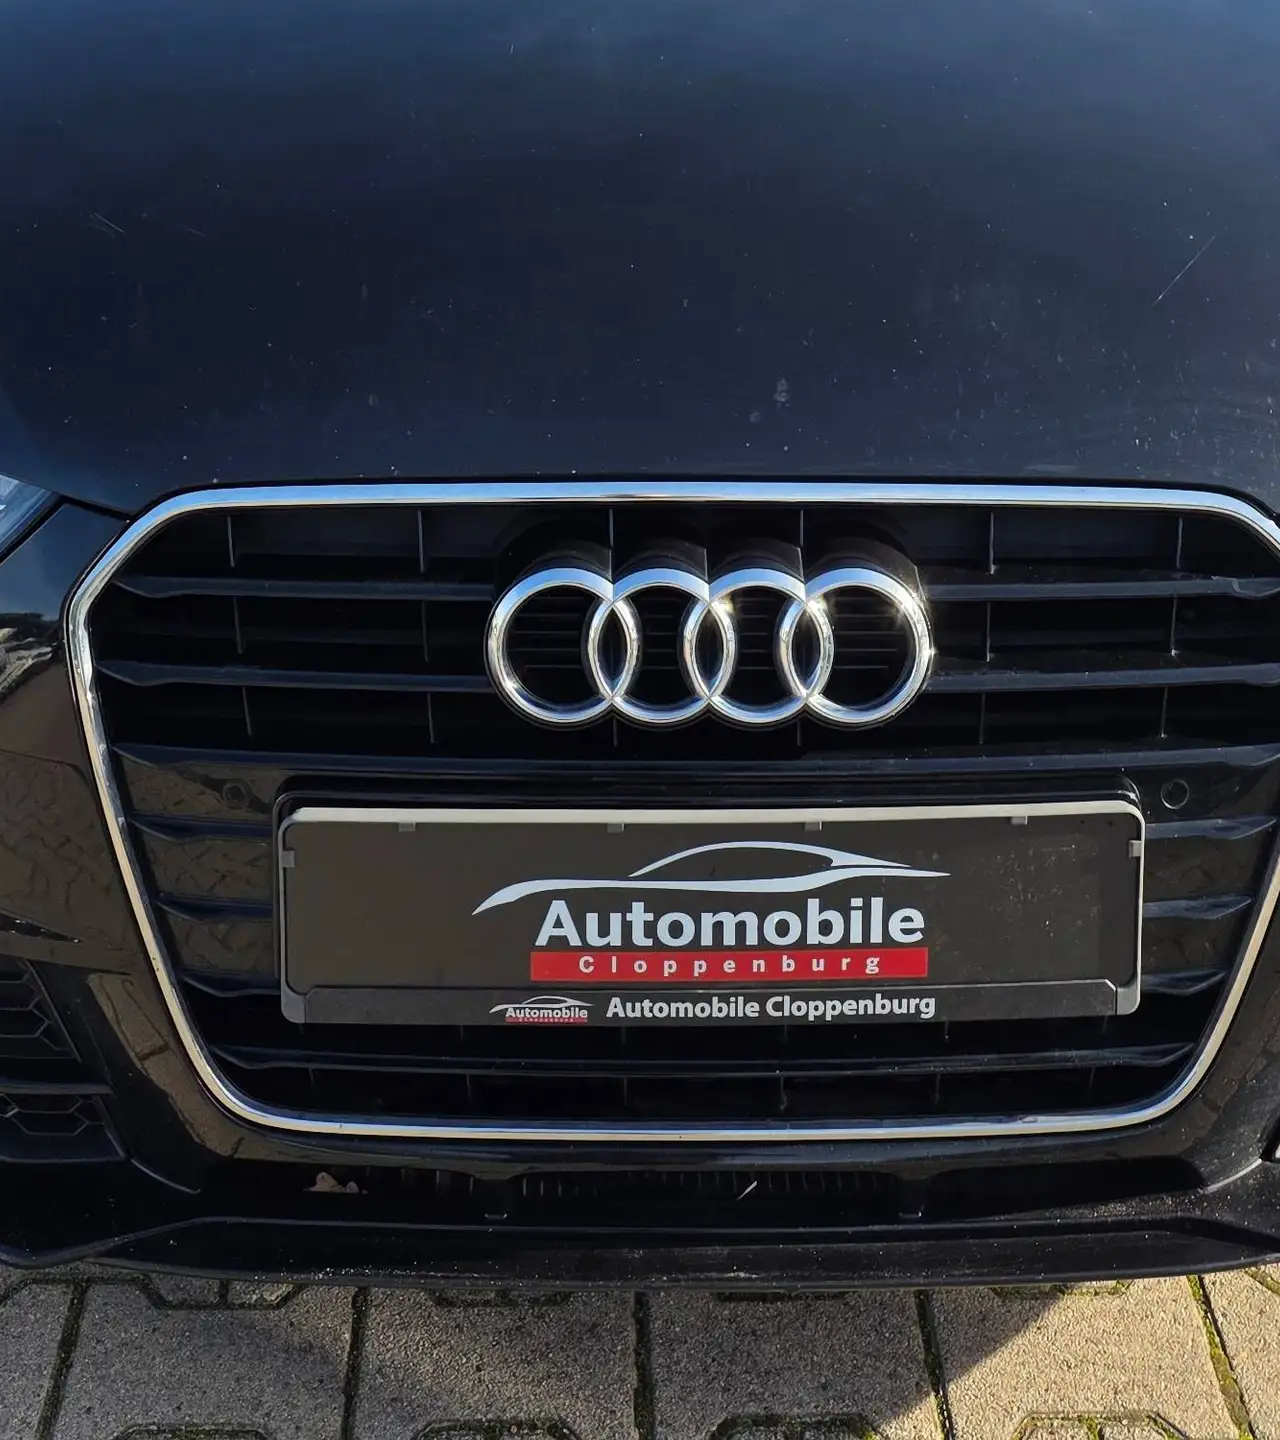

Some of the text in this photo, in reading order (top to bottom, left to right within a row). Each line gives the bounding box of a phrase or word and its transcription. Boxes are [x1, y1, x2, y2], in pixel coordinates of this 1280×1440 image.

[534, 897, 925, 948] Automobile
[578, 955, 881, 977] Cloppenburg
[505, 1006, 588, 1019] Automobile
[606, 993, 937, 1022] Automobile Cloppenburg
